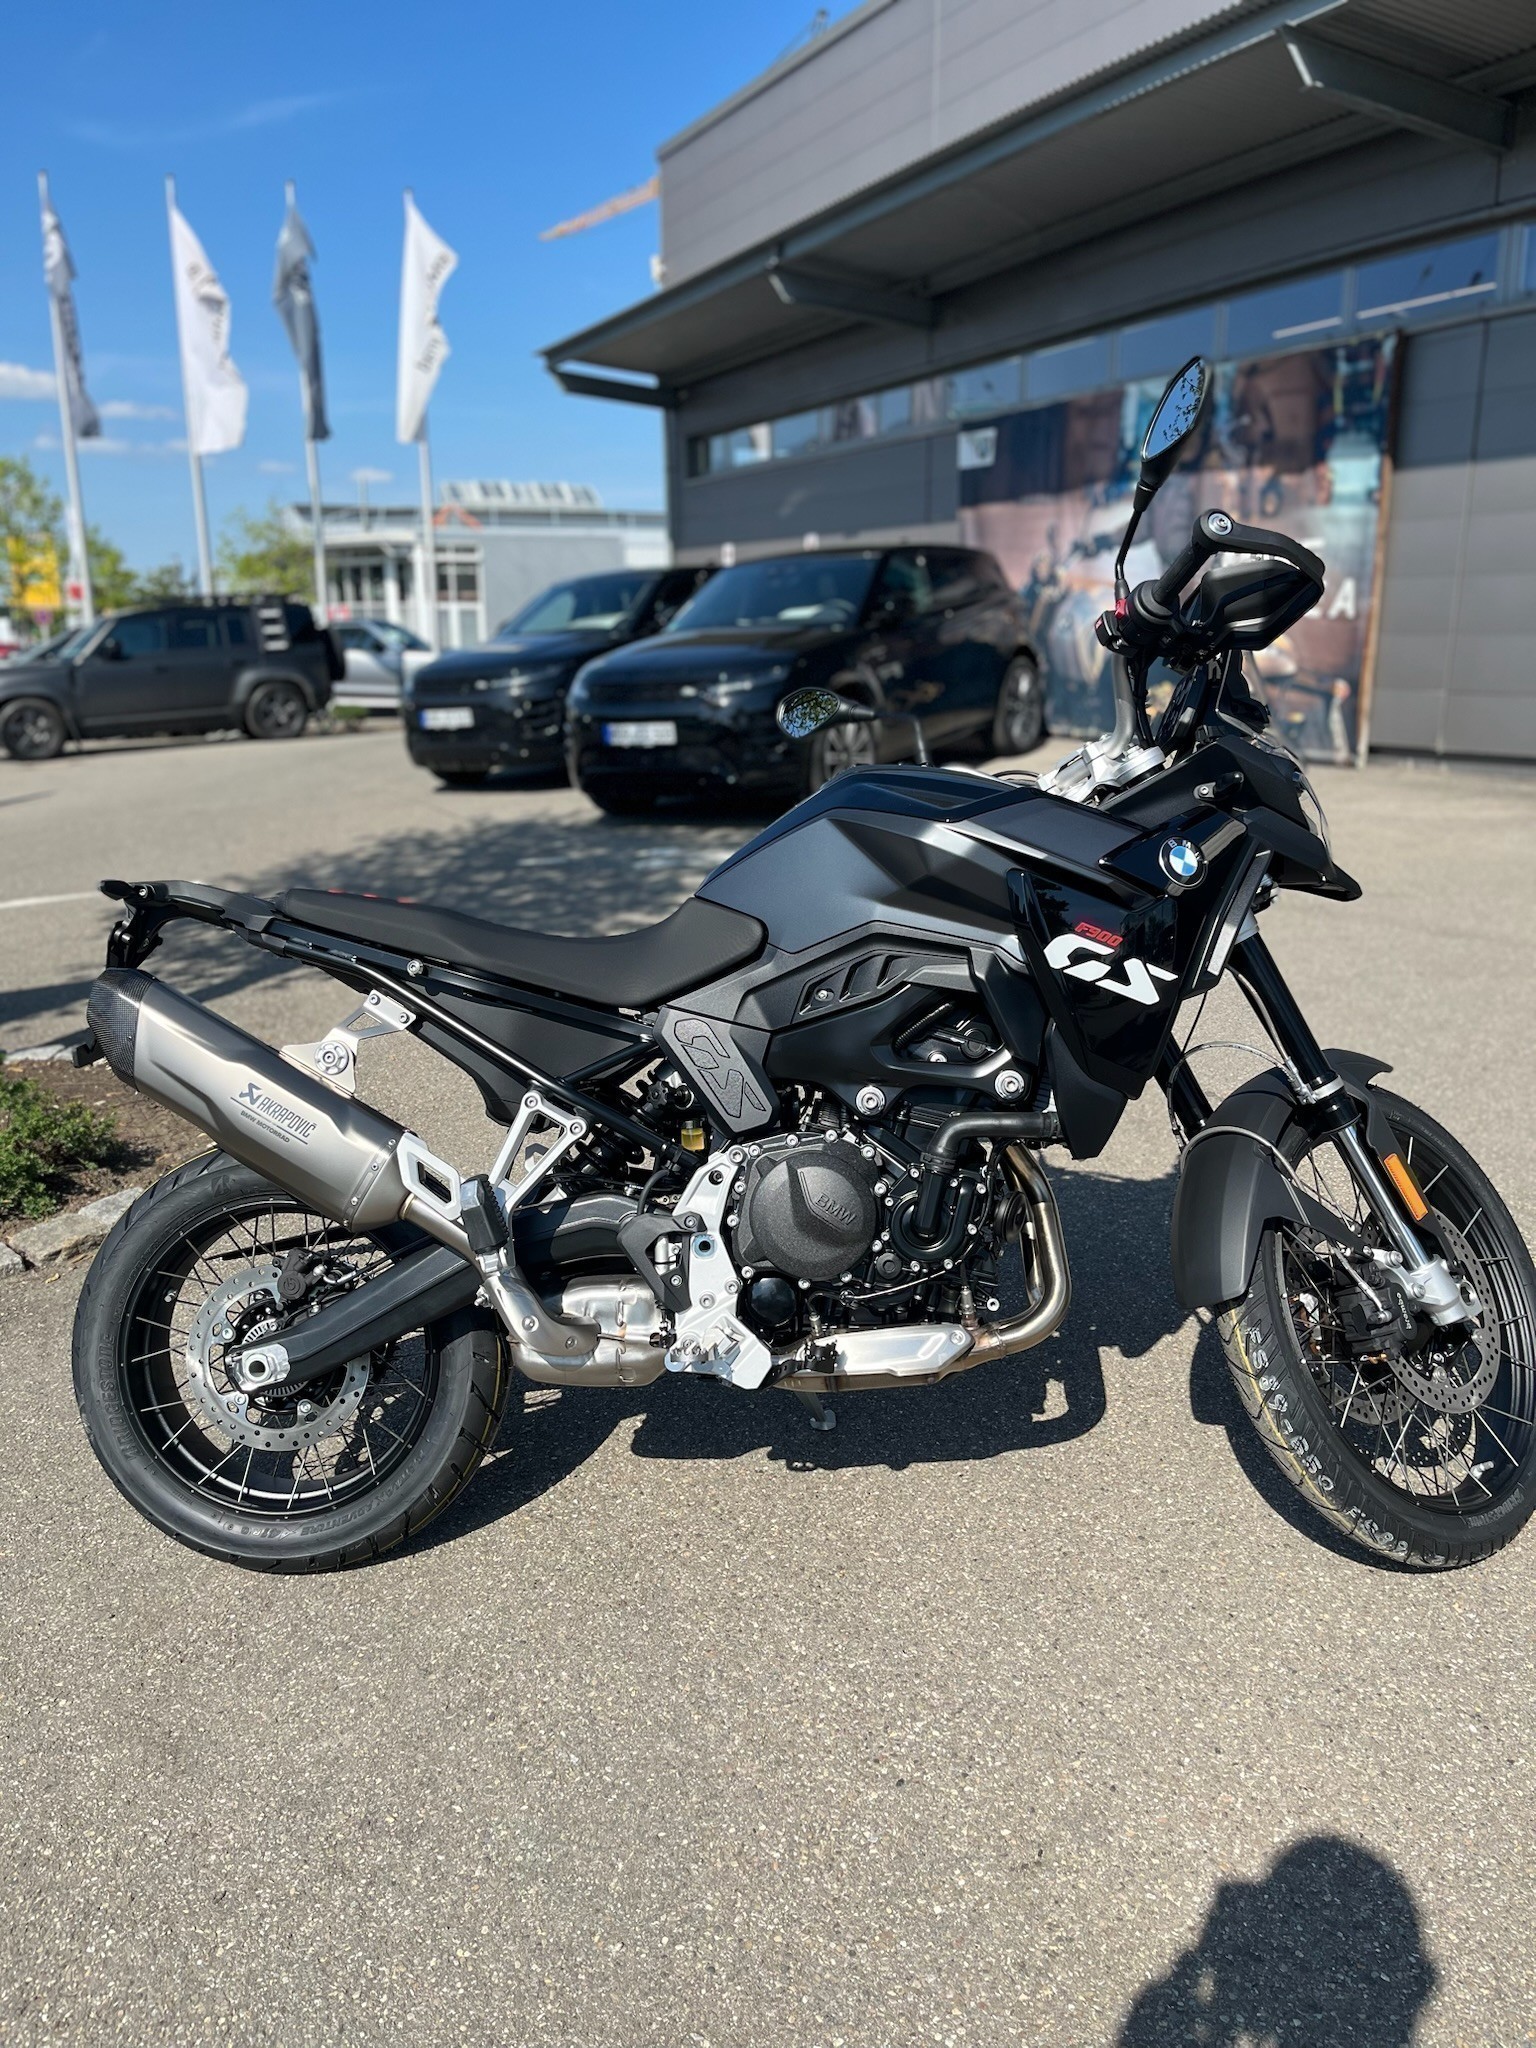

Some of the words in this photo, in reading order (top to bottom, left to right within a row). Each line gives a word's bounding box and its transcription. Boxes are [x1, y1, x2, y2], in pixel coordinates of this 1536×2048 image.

[1074, 921, 1124, 947] F900
[1043, 933, 1179, 1005] GS
[240, 1110, 257, 1123] BMW
[256, 1121, 290, 1143] MOTORRAD
[815, 1193, 857, 1225] BMW
[1396, 1292, 1412, 1330] brembo
[300, 1500, 374, 1536] ADVENTURE
